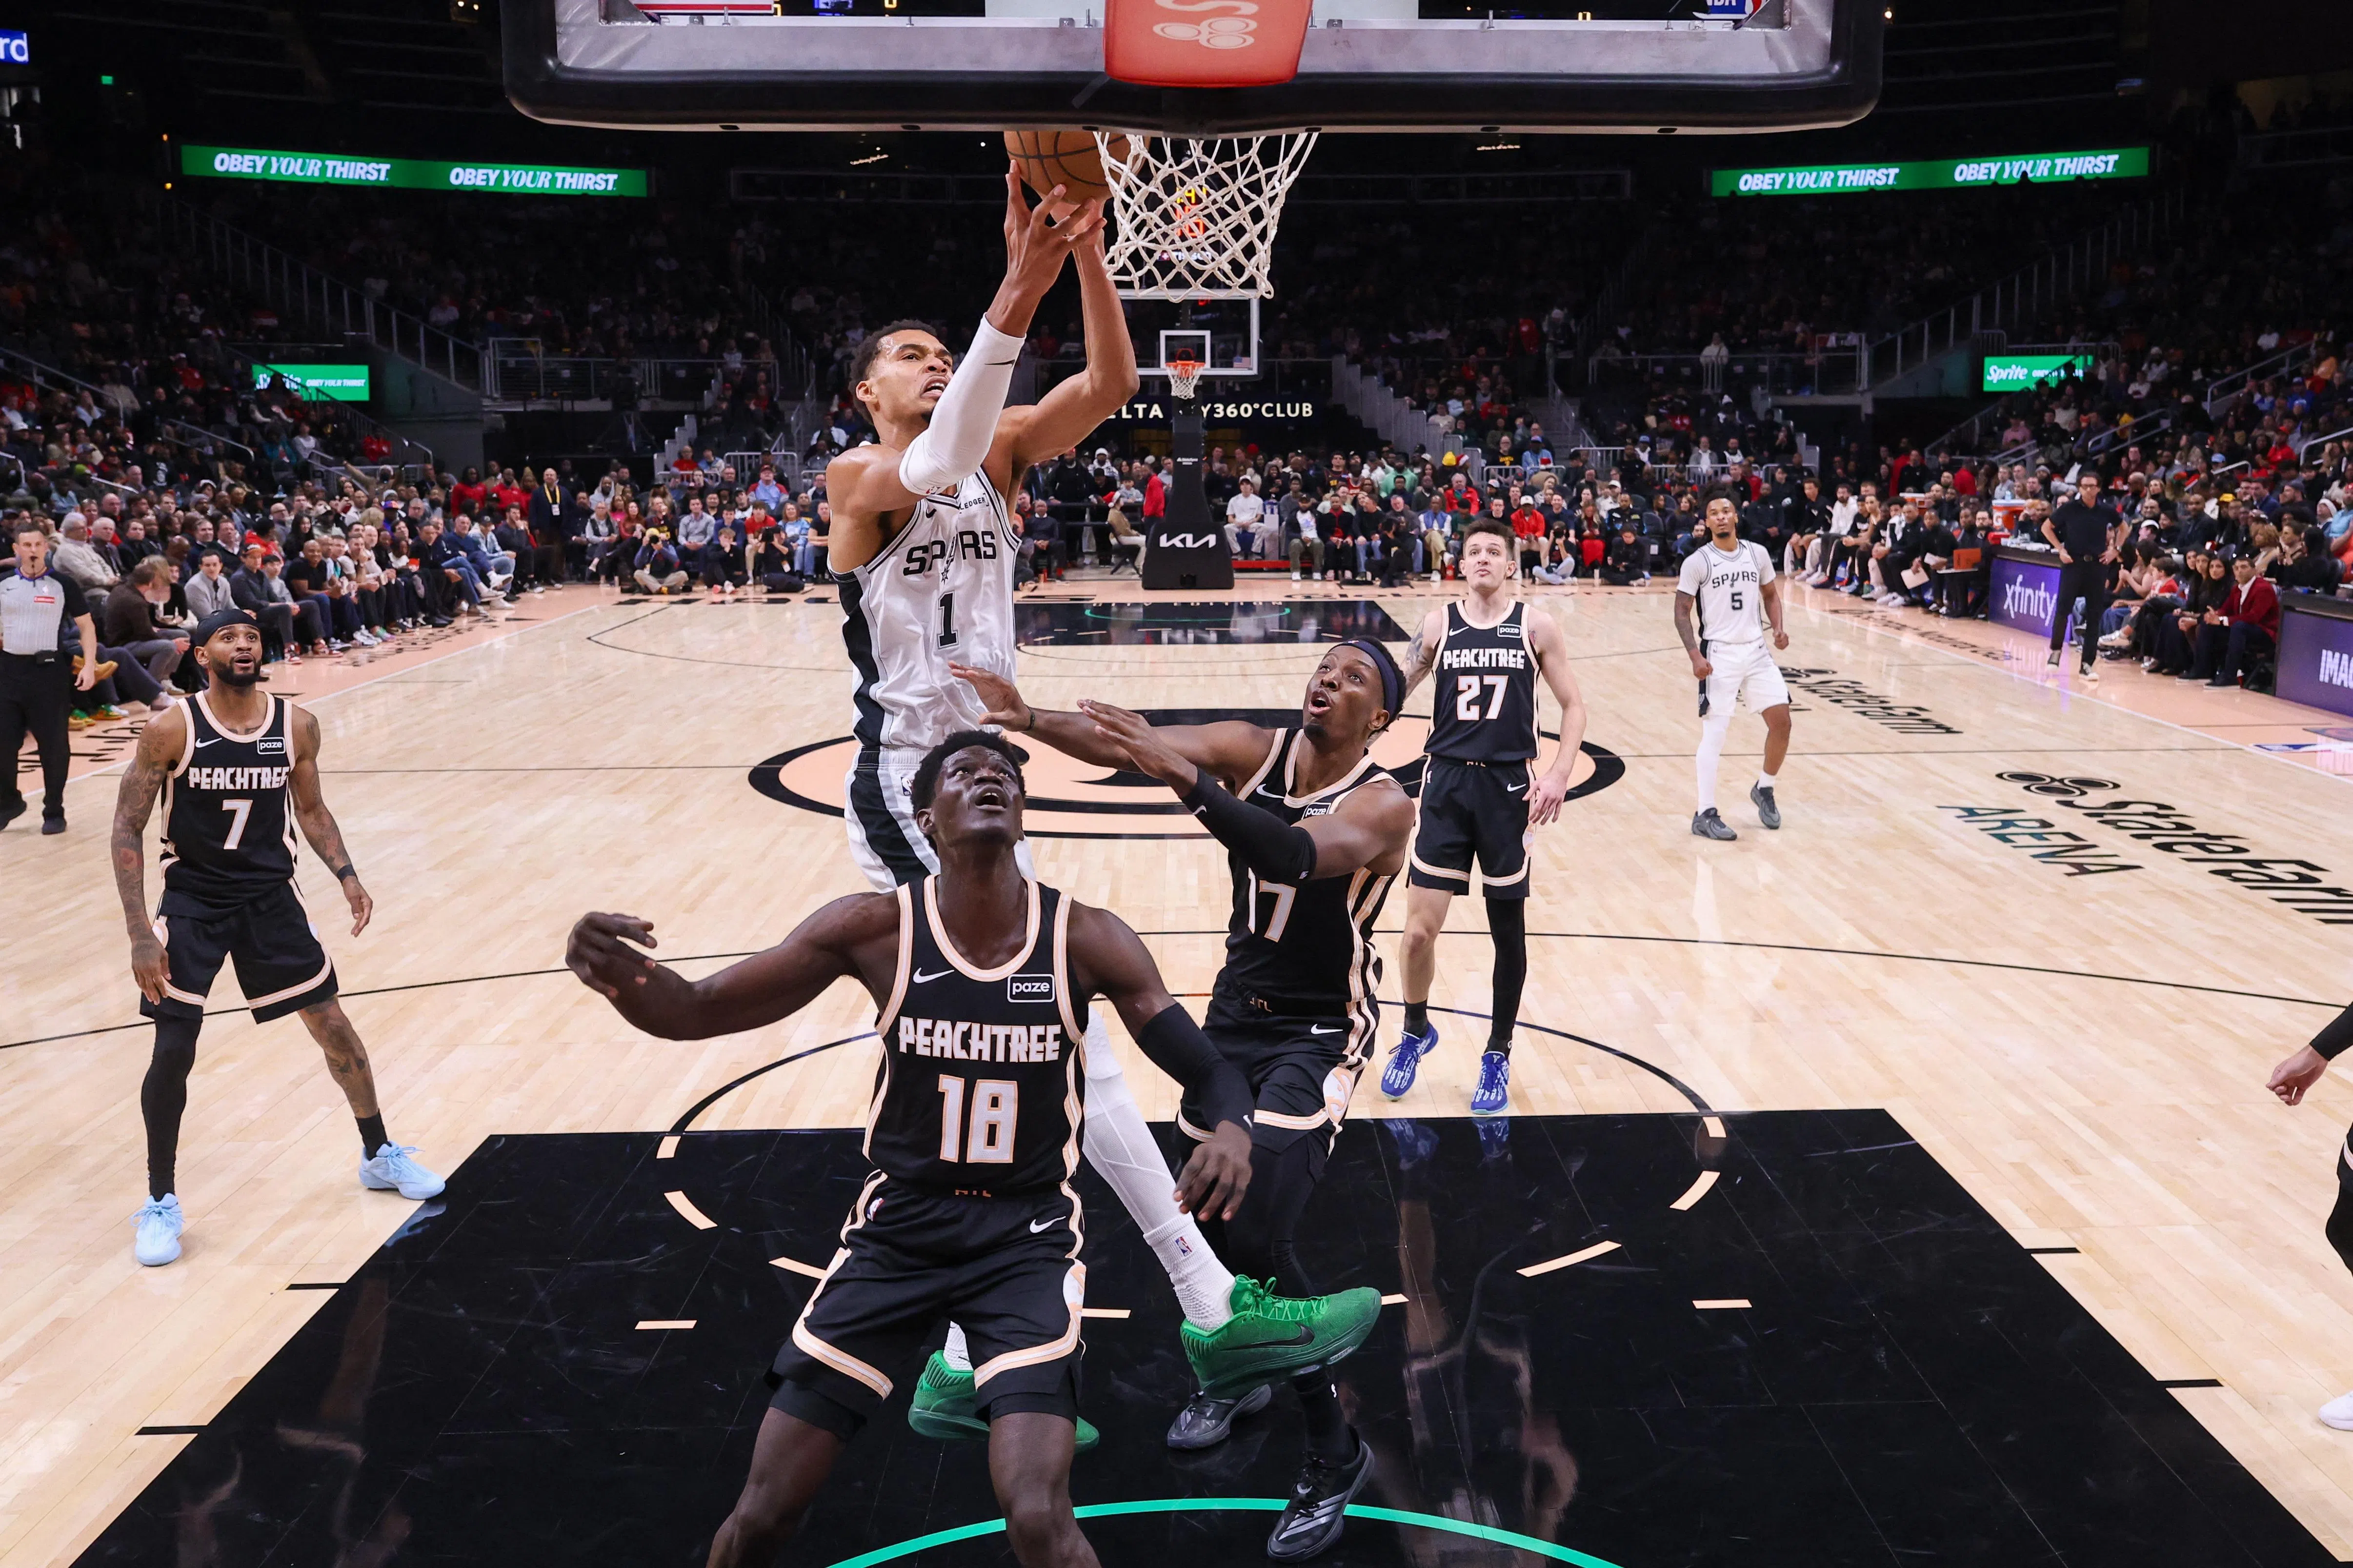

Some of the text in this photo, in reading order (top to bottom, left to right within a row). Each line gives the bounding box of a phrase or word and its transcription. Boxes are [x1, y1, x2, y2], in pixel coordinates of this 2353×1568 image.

[214, 153, 267, 174] OBEY
[269, 156, 322, 177] YOUR
[1954, 161, 2002, 182] OBEY
[2003, 159, 2051, 179] YOUR
[449, 167, 501, 186] OBEY
[502, 169, 552, 188] YOUR
[1739, 172, 1786, 191] OBEY
[1787, 170, 1834, 189] YOUR
[1987, 364, 2028, 383] Sprite
[1107, 403, 1164, 419] LTA
[1160, 533, 1216, 548] KIA
[1712, 571, 1757, 588] SPURS
[1731, 591, 1743, 610] 5
[2004, 574, 2057, 627] xfinity
[938, 590, 960, 649] 1
[1443, 648, 1525, 670] PEACHTREE
[1457, 675, 1509, 721] 27
[260, 741, 282, 750] paze
[188, 766, 289, 790] PEACHTREE
[1305, 808, 1326, 817] paze
[222, 799, 253, 849] 7
[1935, 805, 2145, 877] ARENA
[1248, 867, 1297, 943] 17
[1012, 981, 1050, 995] paze
[898, 1016, 1061, 1063] PEACHTREE
[938, 1074, 1018, 1163] 18
